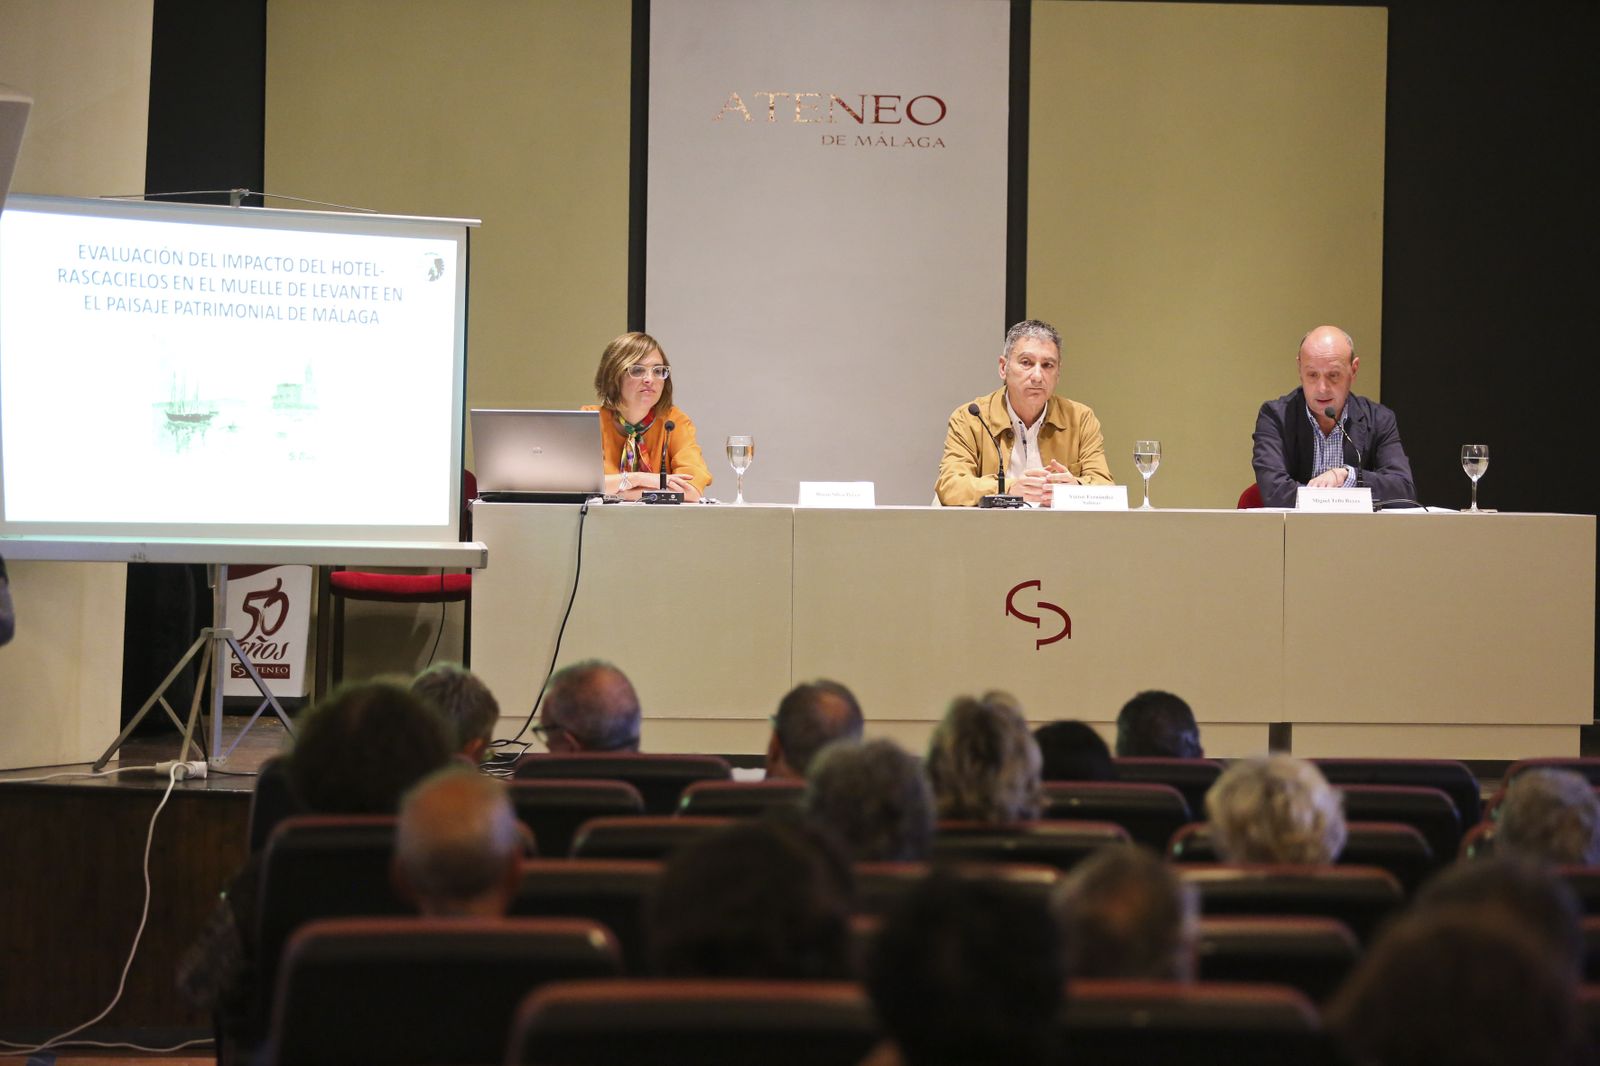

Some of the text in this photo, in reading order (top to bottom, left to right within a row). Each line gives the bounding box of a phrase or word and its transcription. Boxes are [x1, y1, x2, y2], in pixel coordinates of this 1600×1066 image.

[712, 92, 947, 126] ATENEO
[822, 131, 947, 148] DE MÁLAGA
[78, 243, 385, 277] EVALUACIÓN DEL IMPACTO DEL HOTEL-
[57, 268, 403, 302] RASCACIELOS EN EL MUELLE DE LEVANTE EN
[84, 295, 380, 325] EL PAISAJE PATRIMONIAL DE MÁLAGA
[237, 577, 290, 641] 50
[253, 666, 289, 675] TENEO
